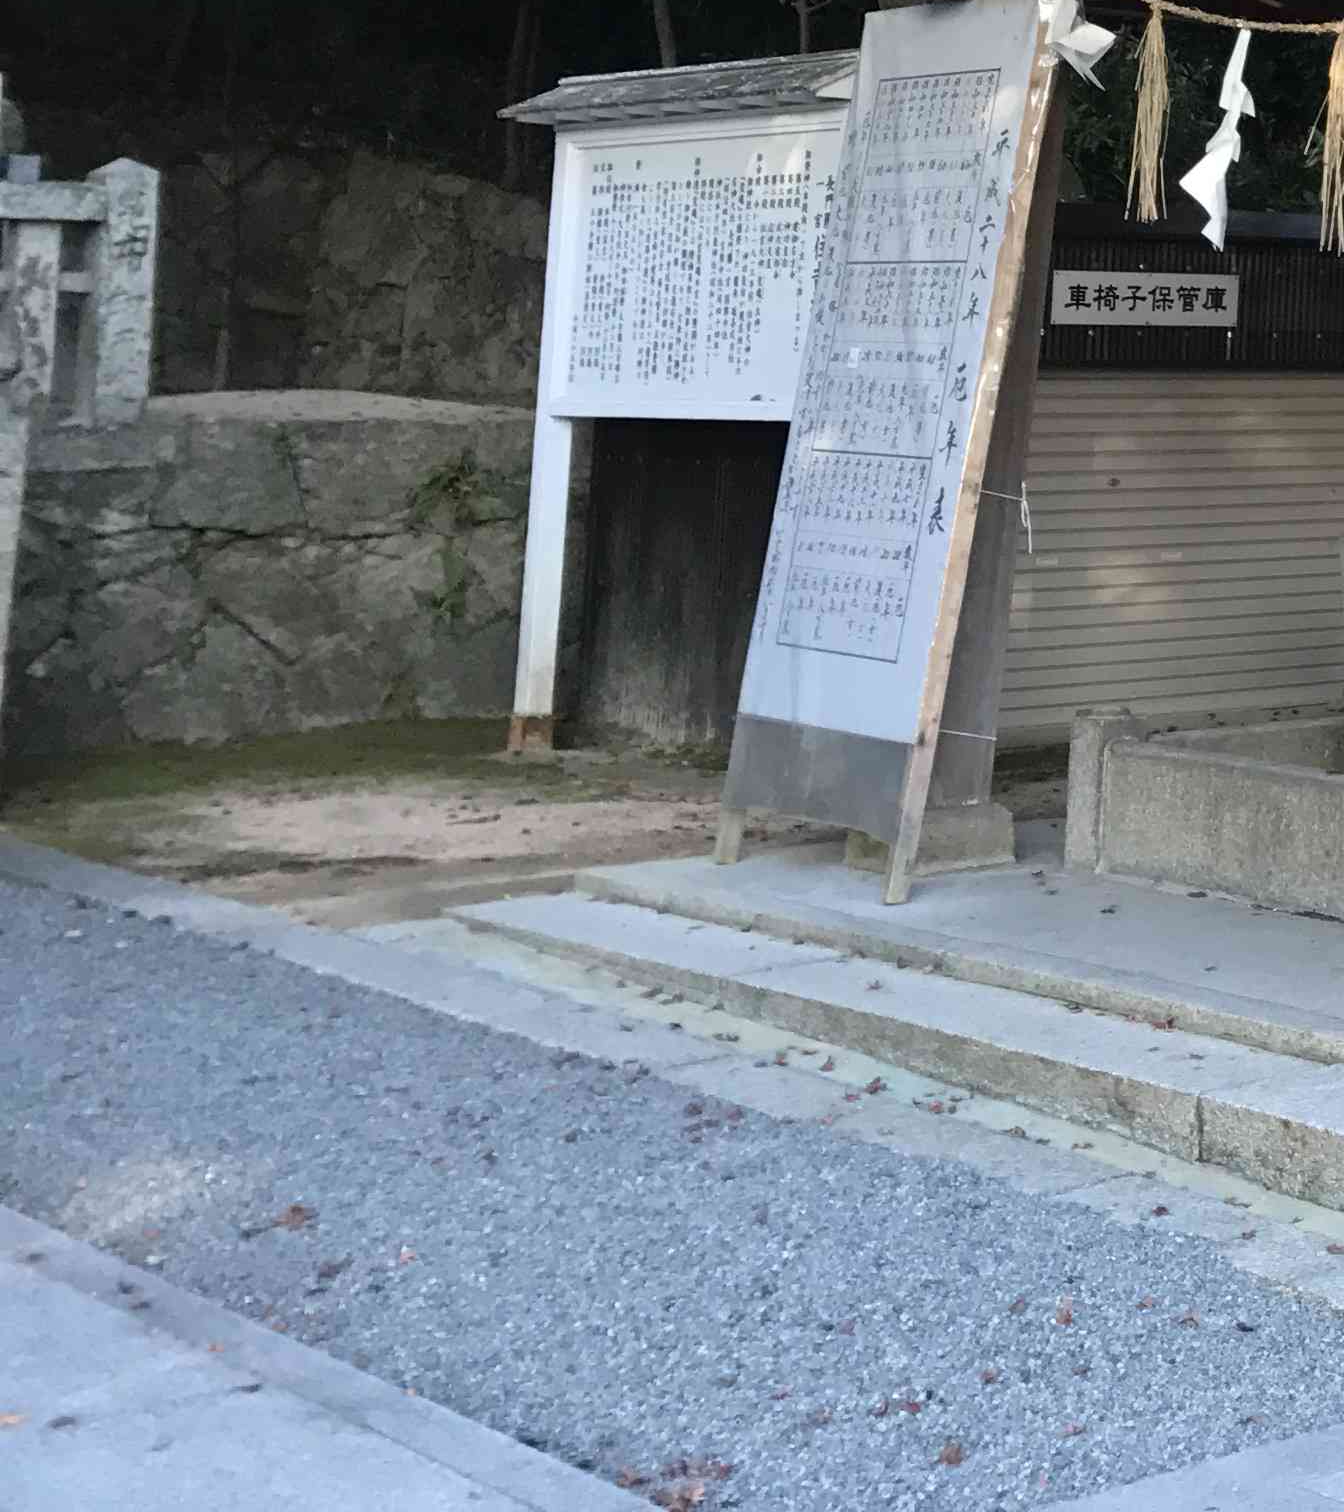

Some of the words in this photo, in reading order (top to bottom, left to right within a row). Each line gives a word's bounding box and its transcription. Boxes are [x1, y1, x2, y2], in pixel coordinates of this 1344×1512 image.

[1064, 283, 1228, 313] 車椅子保管庫
